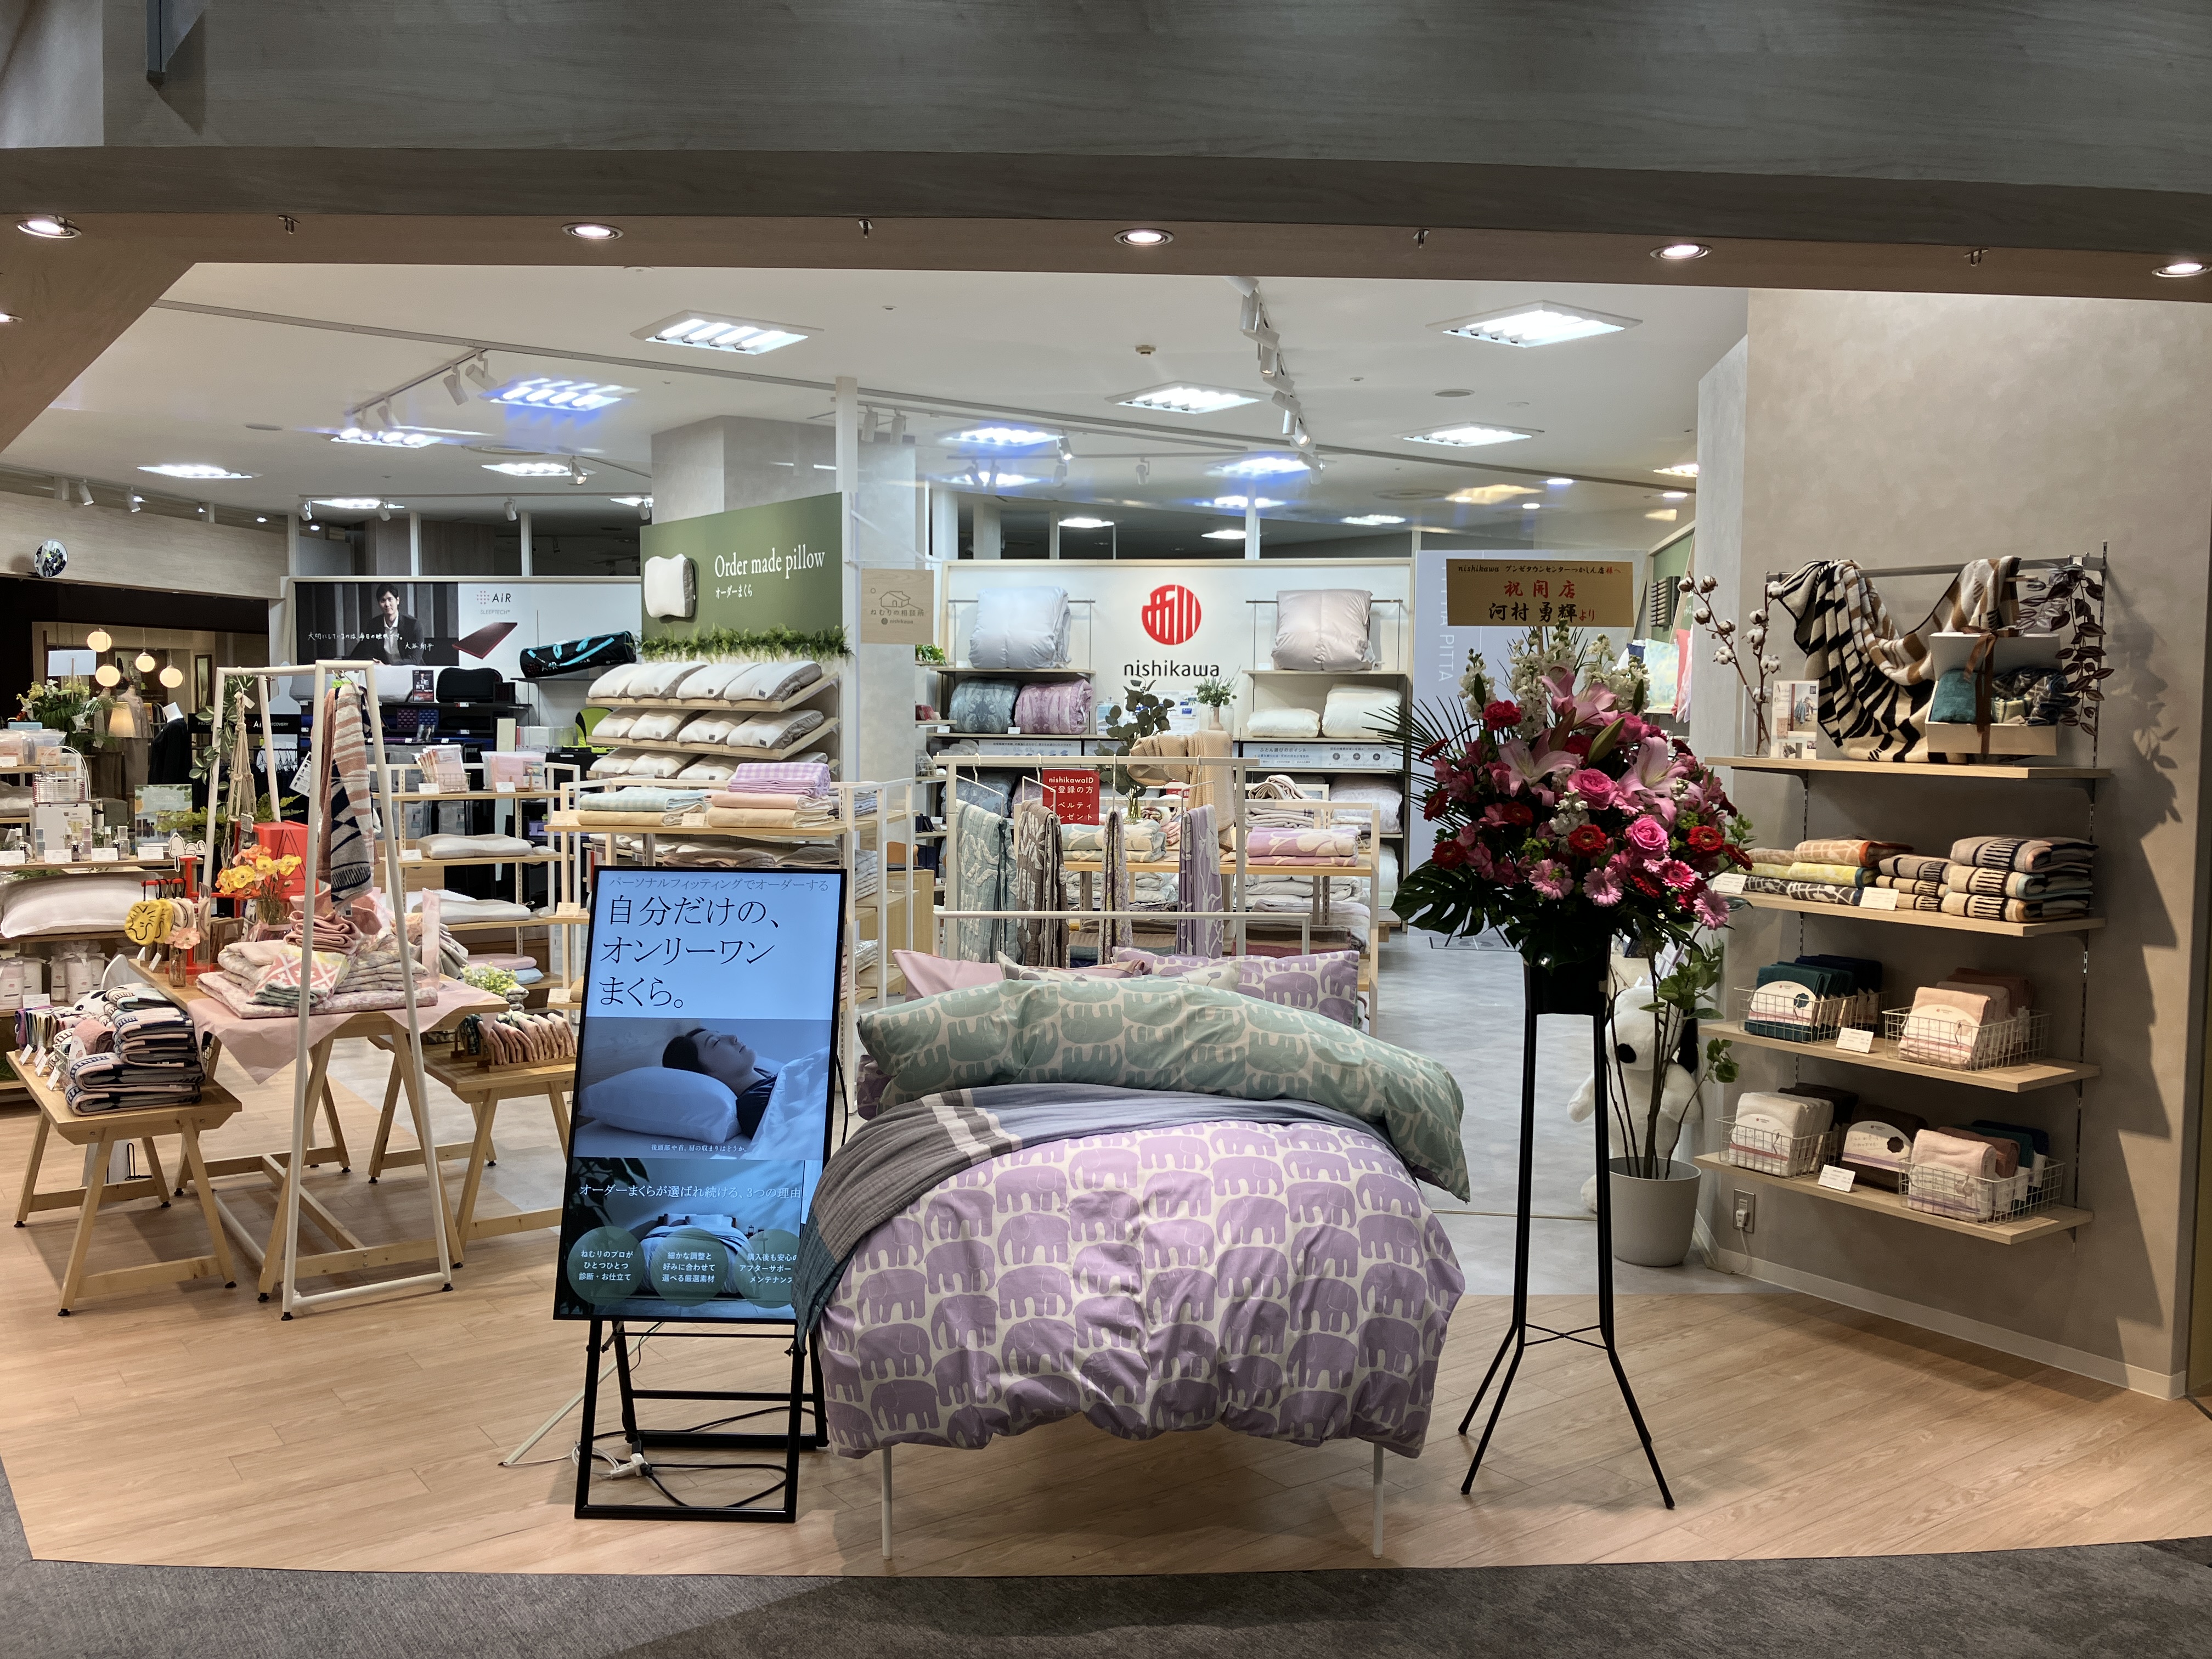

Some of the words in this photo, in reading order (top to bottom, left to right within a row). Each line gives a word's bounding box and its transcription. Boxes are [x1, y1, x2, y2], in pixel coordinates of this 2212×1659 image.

[715, 552, 748, 578] Order
[751, 547, 782, 574] made
[786, 544, 825, 579] pillow
[1458, 565, 1499, 573] nishikawa
[715, 584, 753, 599] オーダーまくら
[1124, 659, 1219, 677] nishikawa
[608, 876, 829, 891] パーソナルフィッティングでオーダーする
[610, 895, 779, 928] 自分だけの、
[600, 936, 775, 966] オンリーワン
[599, 977, 683, 1008] まくら。
[581, 1250, 634, 1259] ねむりのプロが
[667, 1251, 712, 1260] 細かな調整と
[663, 1263, 715, 1271] 好みに合わせて
[579, 1272, 631, 1281] 診断・お仕立て
[662, 1274, 715, 1283] 選べる厳選素材
